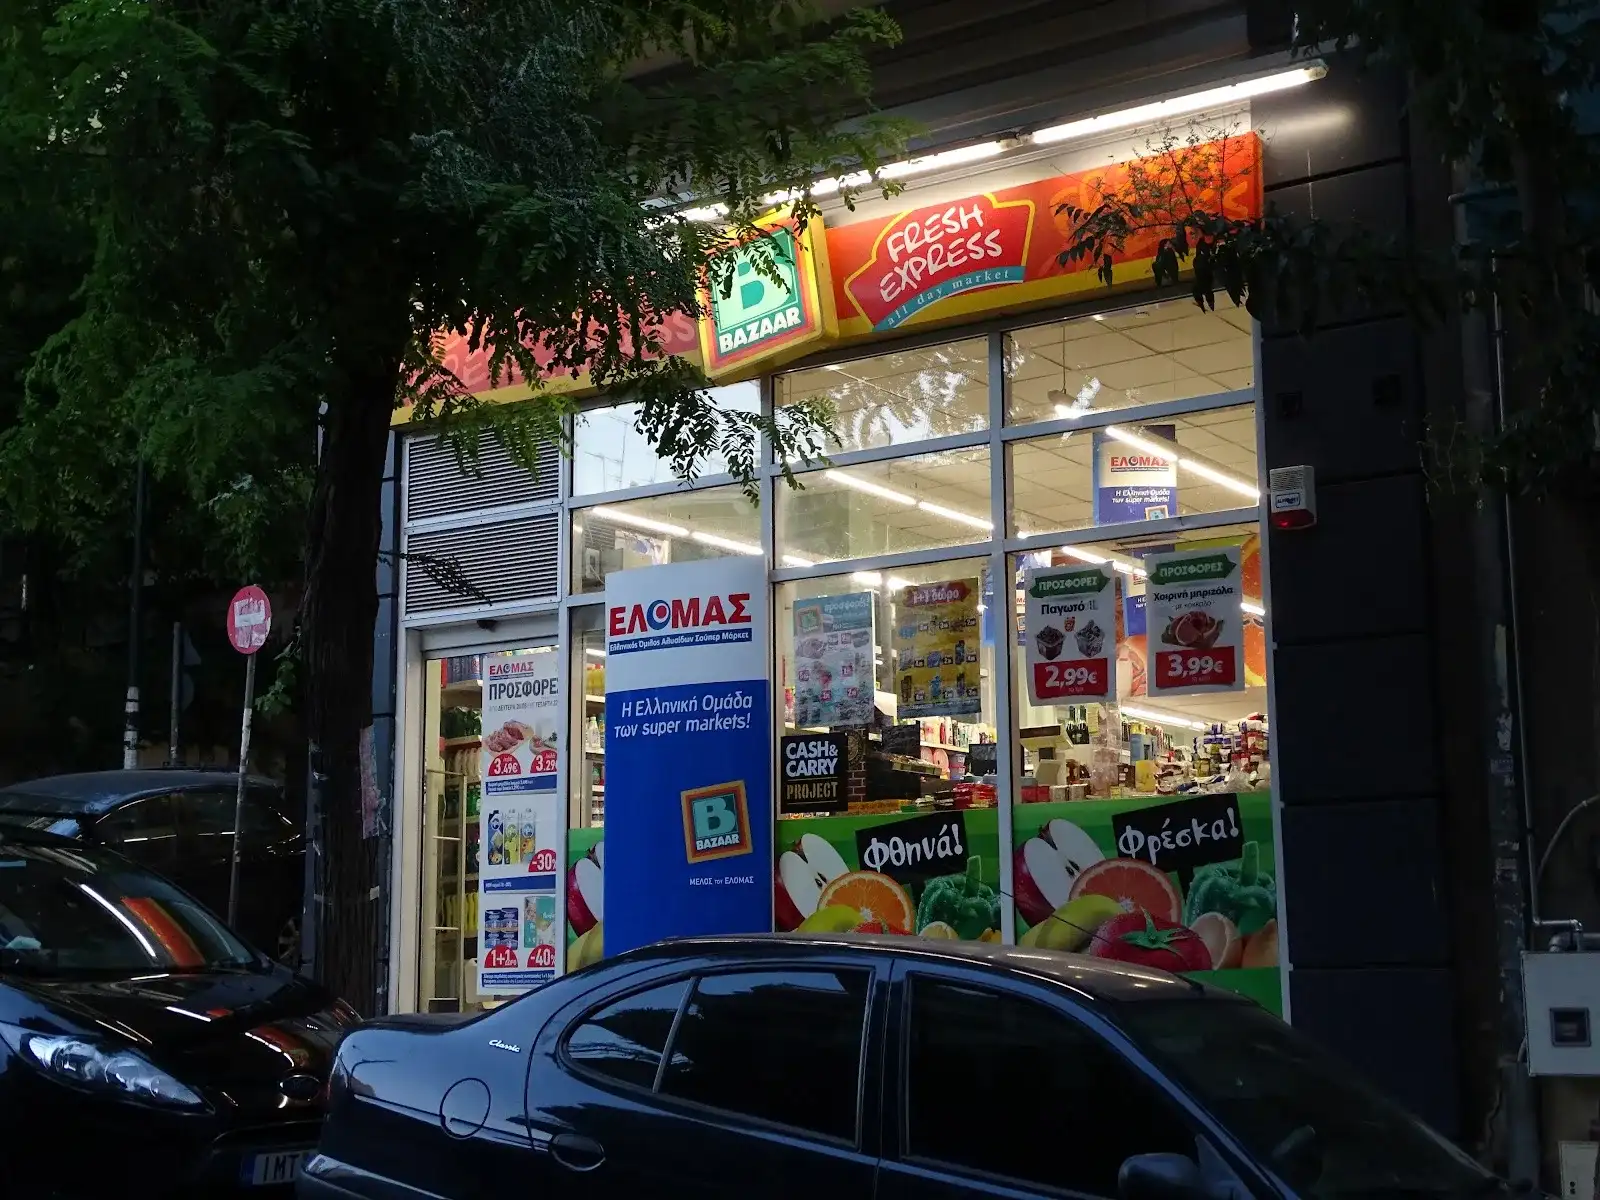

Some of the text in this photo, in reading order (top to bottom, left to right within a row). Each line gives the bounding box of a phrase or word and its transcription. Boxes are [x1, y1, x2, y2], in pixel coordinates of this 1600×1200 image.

[886, 204, 984, 262] FRESH
[879, 229, 1002, 302] EXPRESS
[714, 236, 793, 330] B
[887, 269, 1009, 325] all day market
[719, 307, 801, 353] BAZAAR
[1160, 562, 1223, 577] ΠΡΟΣΦΟΡΕΣ
[1038, 576, 1098, 591] ΠΡΟΣΦΟΡΕΣ
[1153, 585, 1234, 601] Χοιρινή μπριζόλα
[609, 593, 752, 636] ΕΛΟΜΑΣ
[1041, 600, 1085, 616] Παγωτό
[489, 661, 534, 675] ΕΛΟΜΑΣ
[1045, 665, 1097, 689] 2,99€
[1168, 654, 1223, 678] 3,99€
[489, 677, 559, 700] ΠΡΟΣΦΟΡΕ
[622, 691, 753, 718] Η Ελληνική Ομάδα
[614, 713, 751, 738] των super markets!
[785, 740, 838, 759] CASH&
[785, 758, 838, 777] CARRY
[786, 782, 838, 799] PROJECT
[693, 797, 736, 838] B
[696, 834, 740, 850] BAZAAR
[863, 823, 964, 872] Φθηνά!
[1118, 807, 1239, 865] Φρέσκα!
[689, 877, 713, 886] ΜΕΛΟΣ
[724, 875, 754, 884] ΕΛΟΜΑΣ
[489, 1040, 521, 1053] Classic
